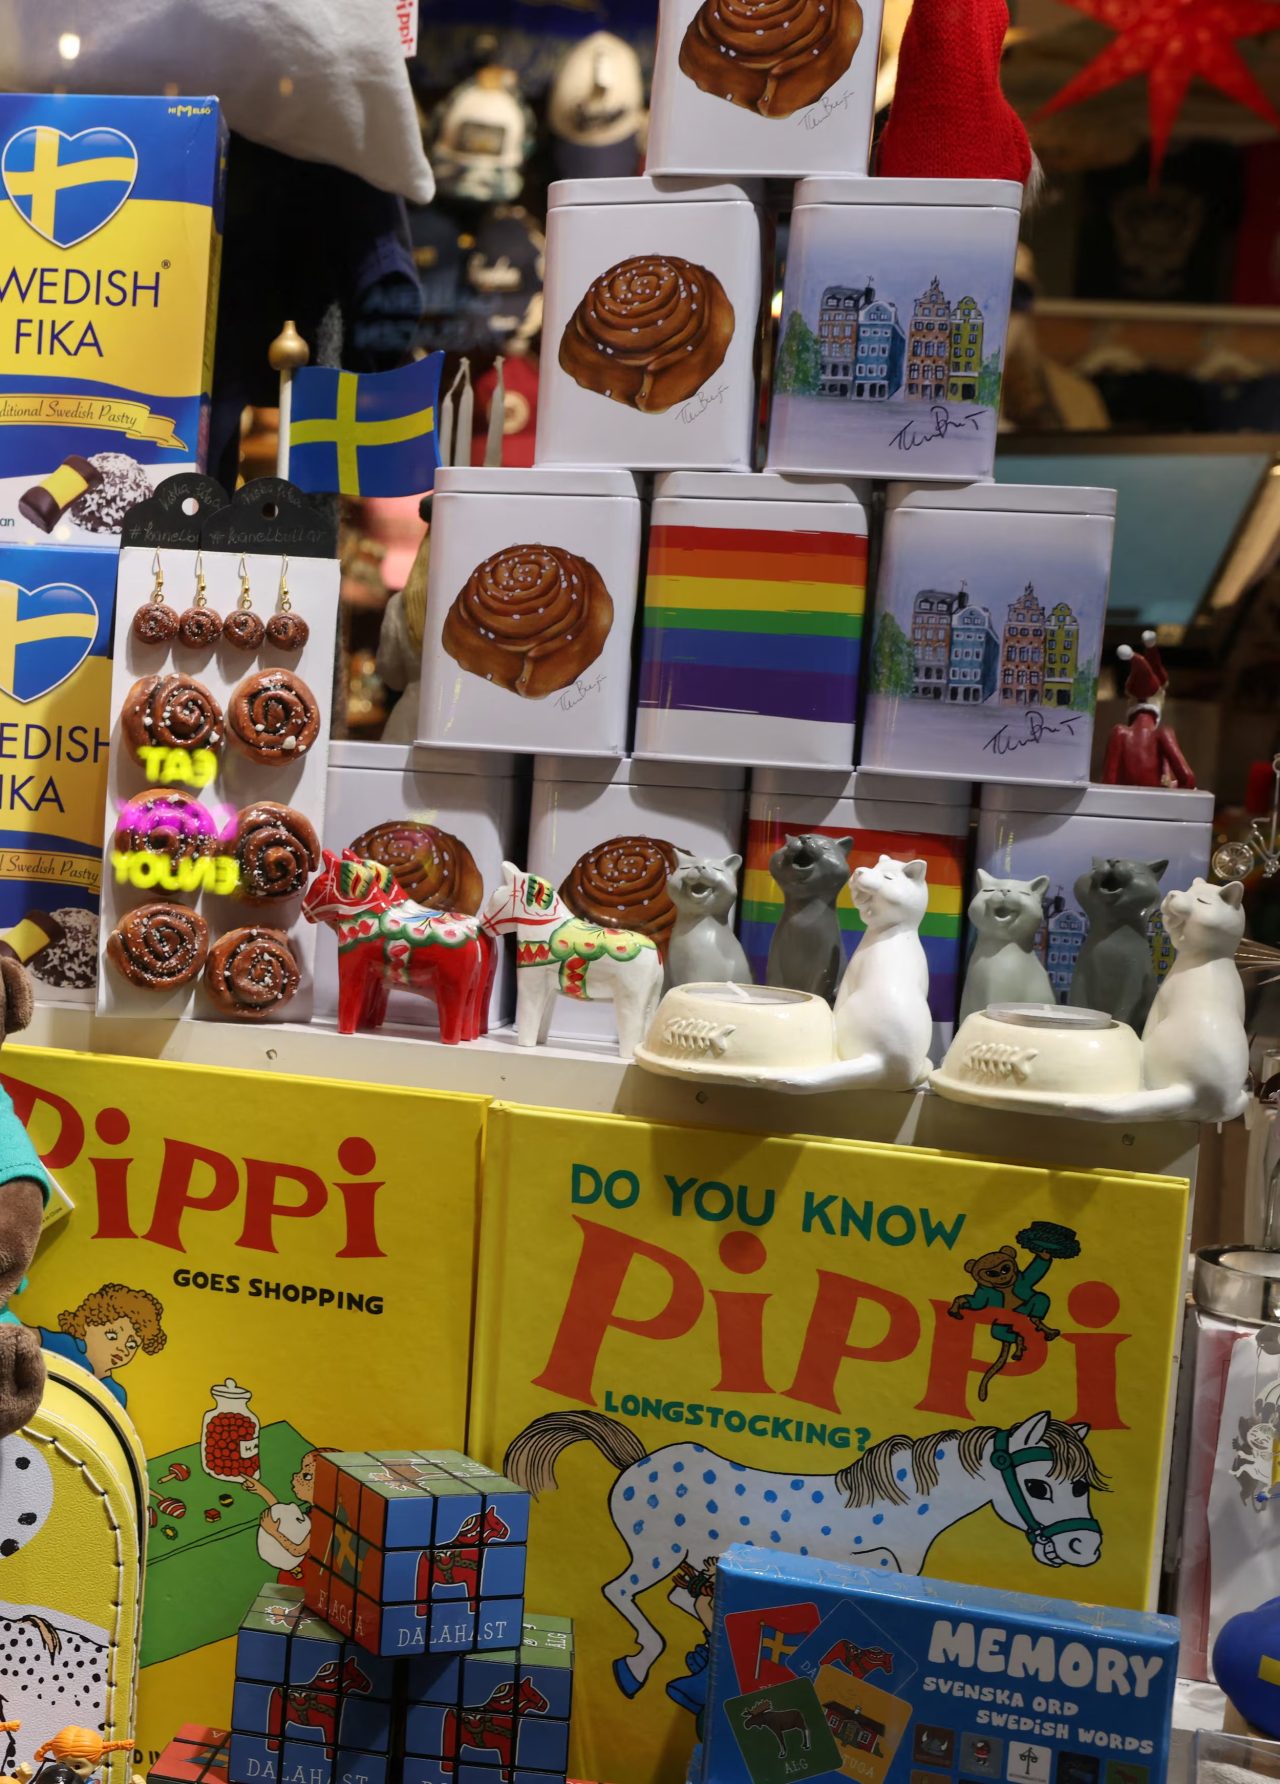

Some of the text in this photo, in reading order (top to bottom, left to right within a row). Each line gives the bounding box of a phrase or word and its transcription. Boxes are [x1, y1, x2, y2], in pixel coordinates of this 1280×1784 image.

[14, 318, 104, 357] FIKA
[45, 402, 94, 420] Swedish
[97, 404, 138, 428] Pastry
[6, 855, 55, 875] Swedish
[59, 860, 100, 883] Pastry
[570, 1163, 967, 1251] DO YOU KNOW
[173, 1268, 385, 1315] GOES SHOPPING
[604, 1390, 871, 1452] LONGSTOCKING?
[927, 1620, 1163, 1697] MEMORY
[923, 1676, 1079, 1716] SVENSKA ORD
[1078, 1728, 1154, 1755] WORDS
